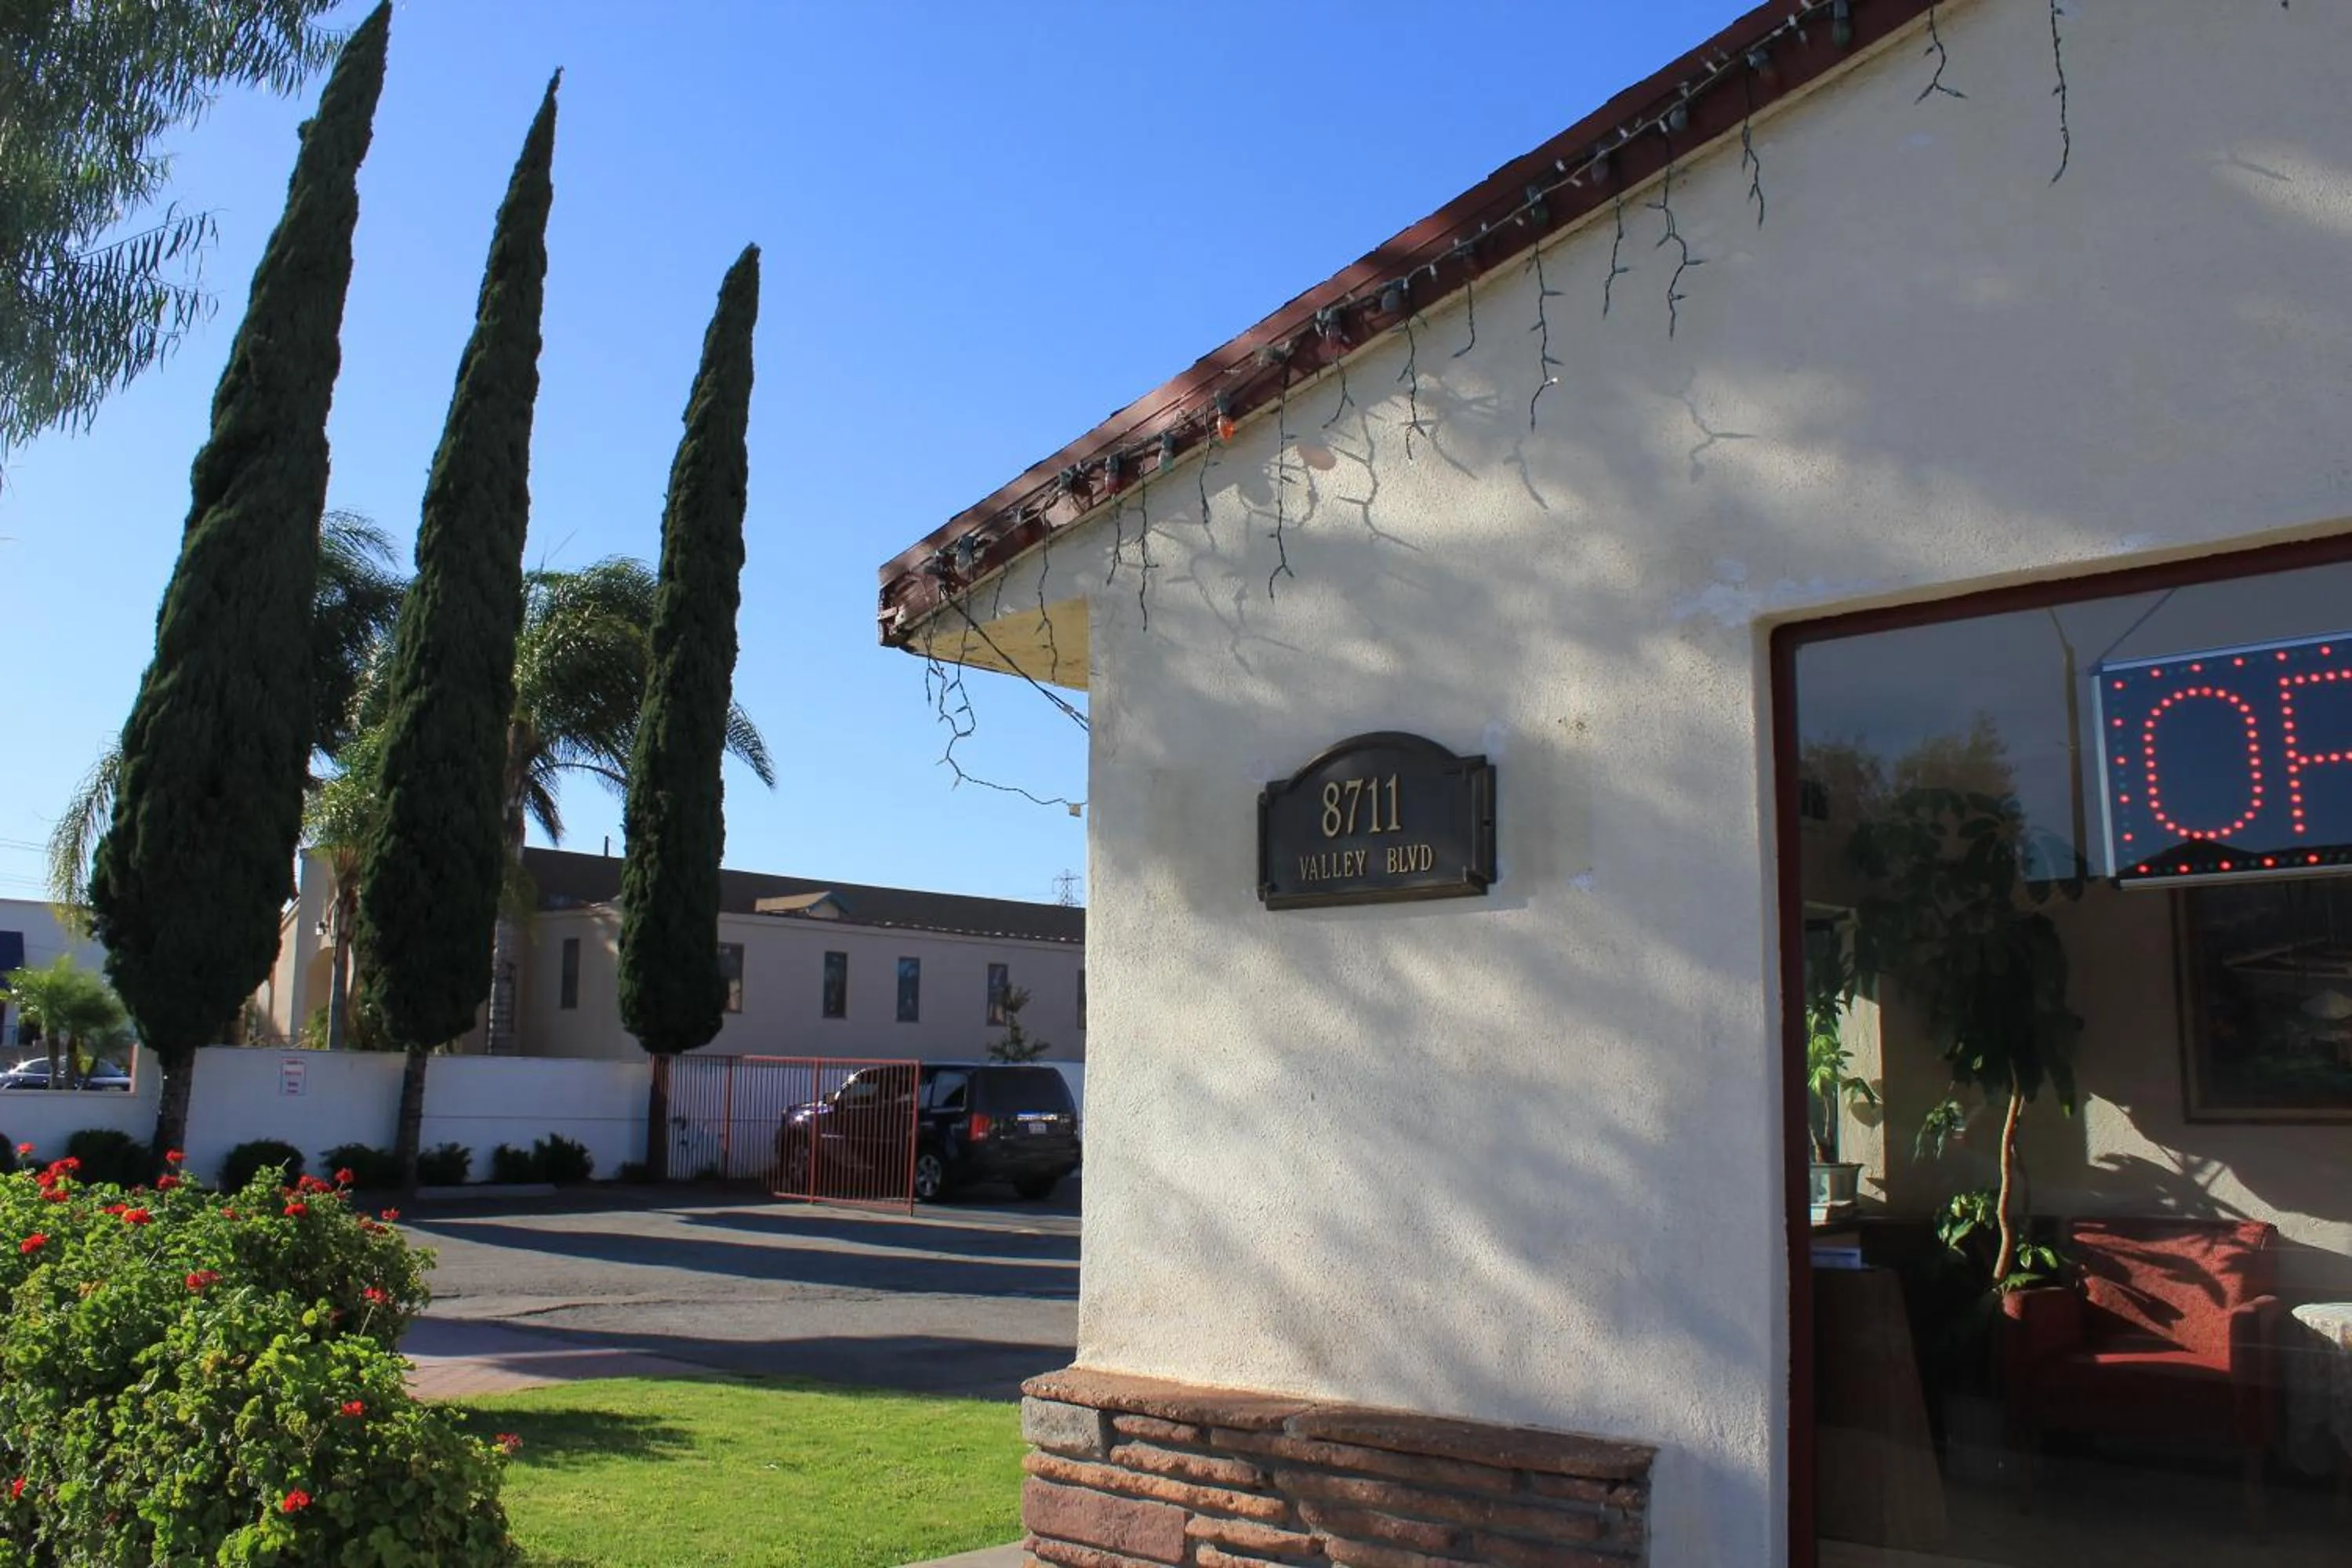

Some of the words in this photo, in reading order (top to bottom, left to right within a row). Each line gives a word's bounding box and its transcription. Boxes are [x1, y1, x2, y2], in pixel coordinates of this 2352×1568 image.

[1321, 772, 1402, 838] 8711
[1299, 849, 1367, 880] VALLEY
[1386, 844, 1433, 874] BLVD
